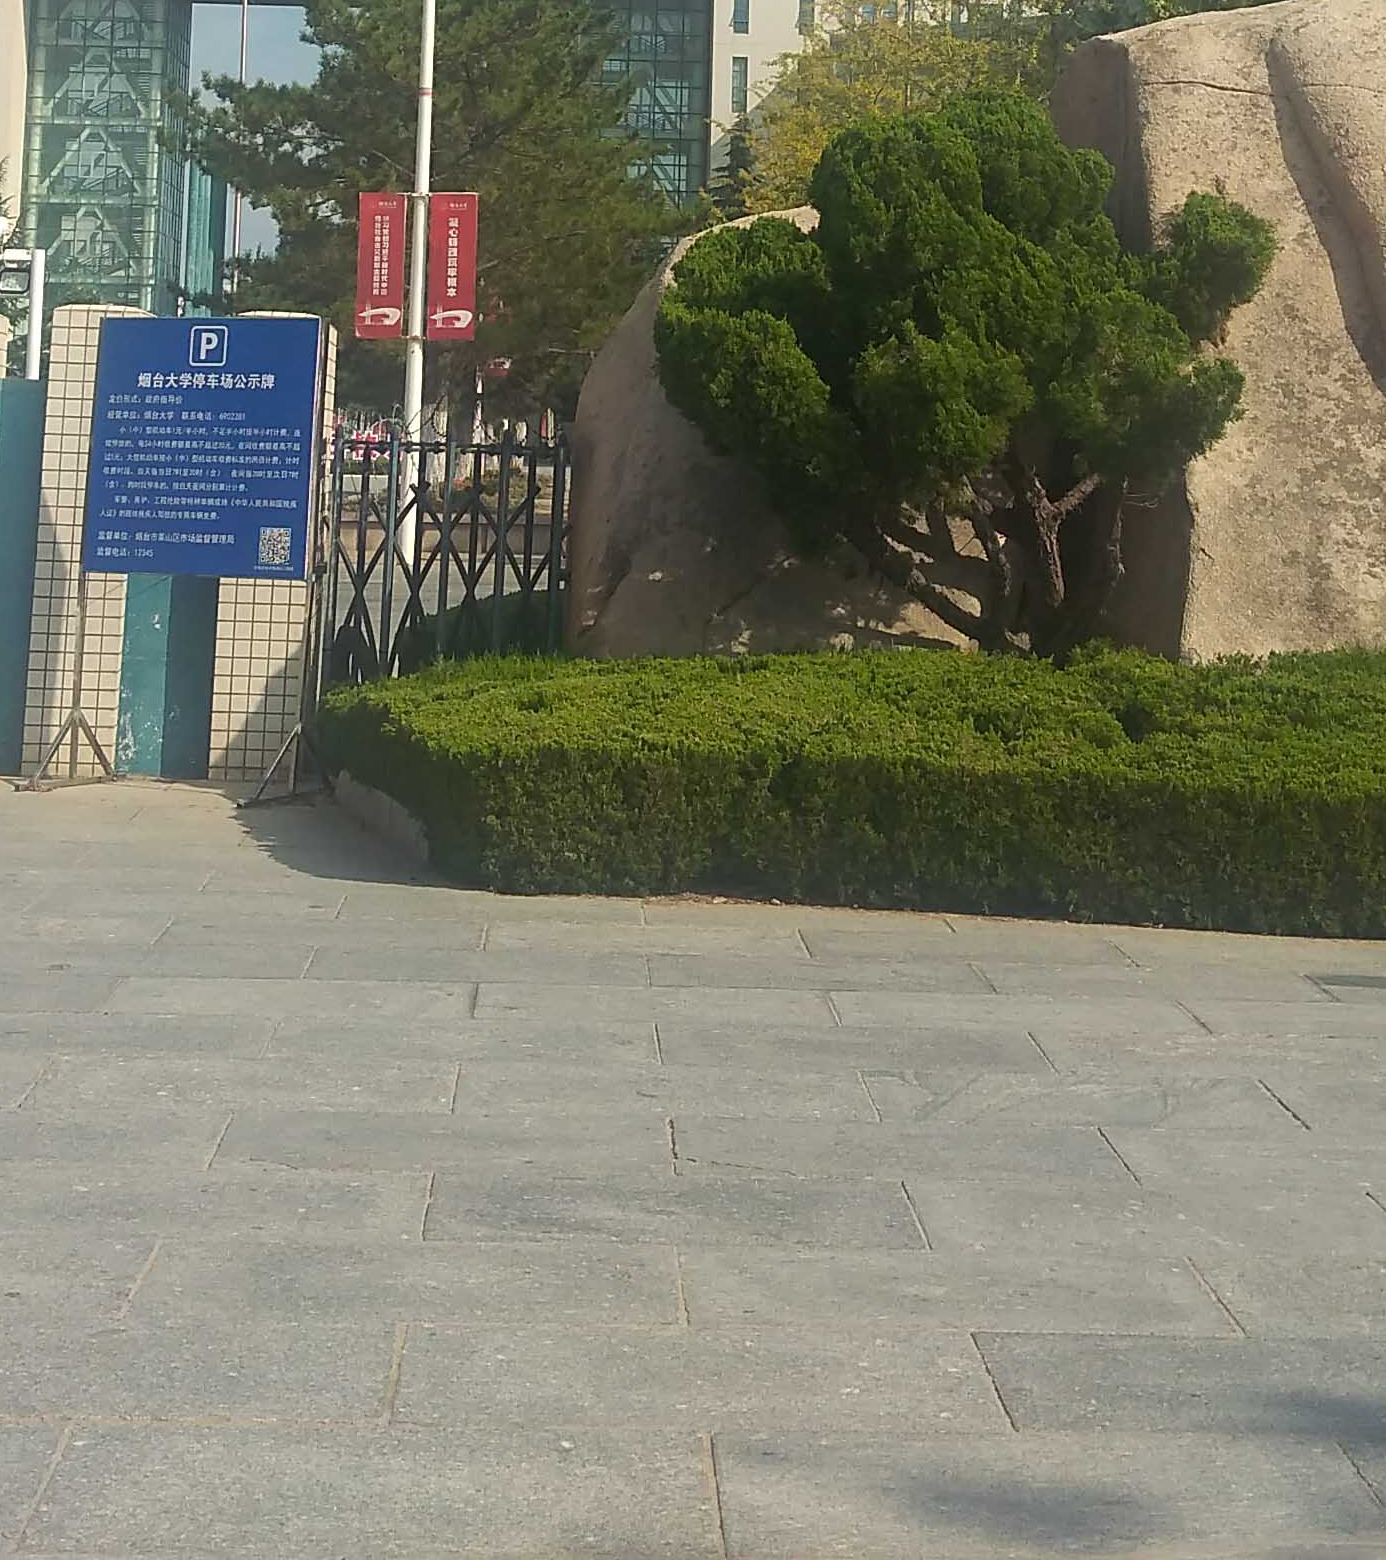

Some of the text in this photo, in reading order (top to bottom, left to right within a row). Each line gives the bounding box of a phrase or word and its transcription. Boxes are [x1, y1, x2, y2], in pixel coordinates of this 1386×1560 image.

[199, 332, 219, 360] P
[137, 372, 276, 390] 烟台大学停车场公示牌
